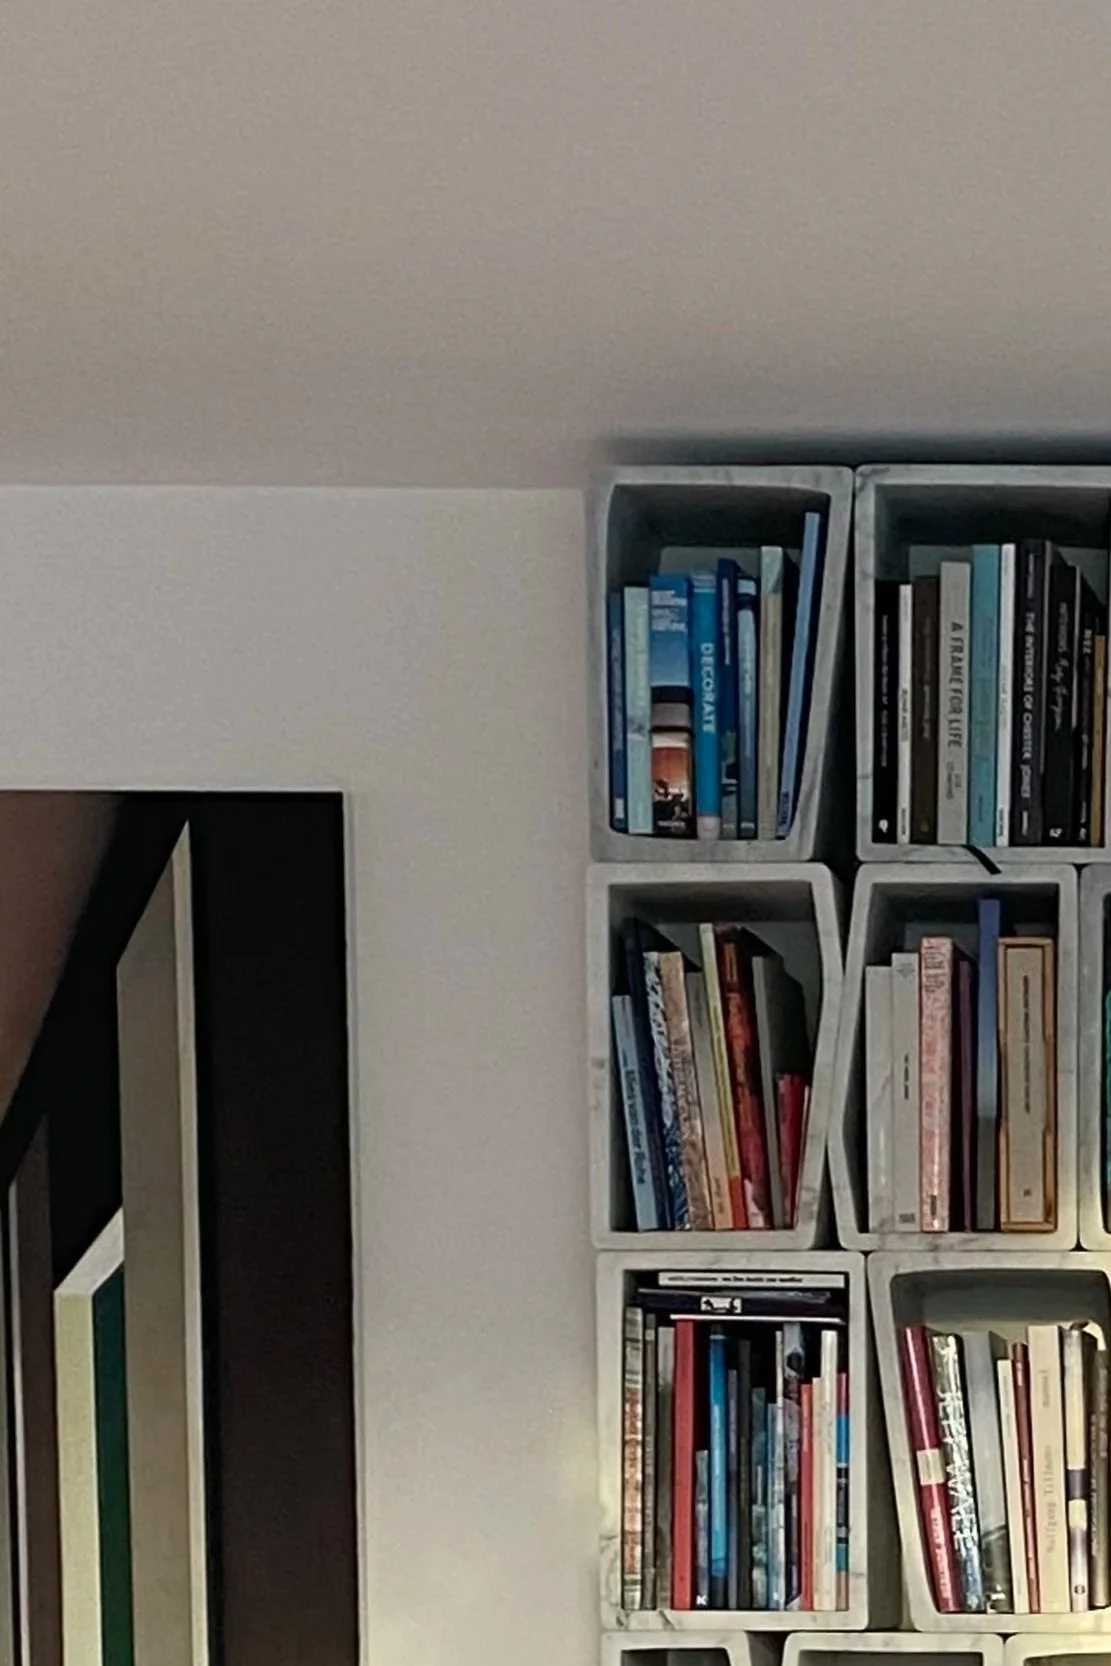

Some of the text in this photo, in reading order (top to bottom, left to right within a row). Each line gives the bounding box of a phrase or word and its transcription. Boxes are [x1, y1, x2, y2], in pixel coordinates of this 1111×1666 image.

[949, 621, 965, 633] A
[949, 635, 965, 684] FRAME
[1022, 635, 1035, 692] INTERIORS
[700, 642, 717, 735] DECORATE
[948, 686, 964, 713] FOR
[1022, 694, 1034, 709] OF
[947, 716, 963, 749] LIFE
[1020, 763, 1033, 799] JONES
